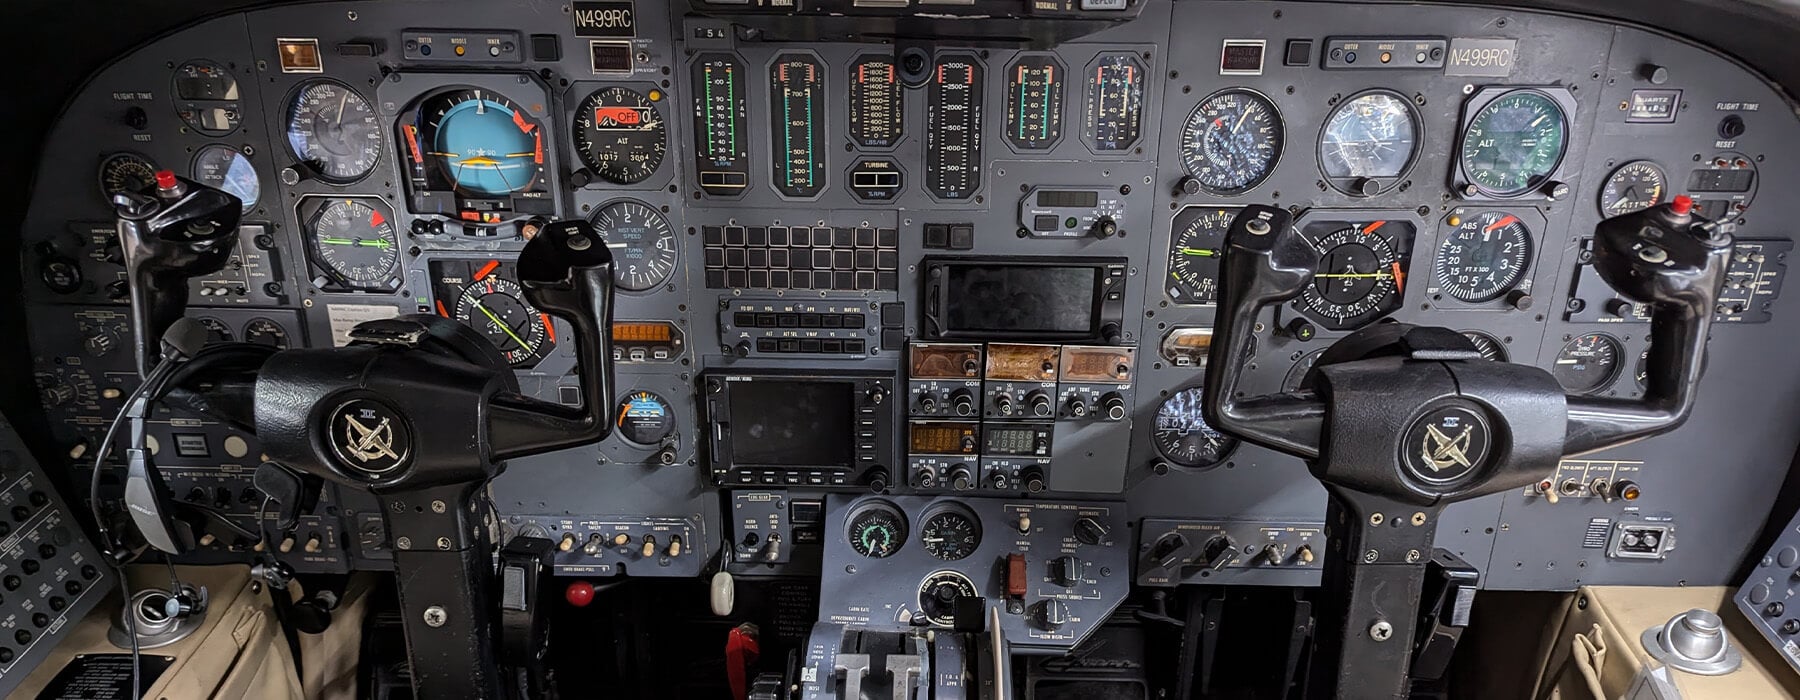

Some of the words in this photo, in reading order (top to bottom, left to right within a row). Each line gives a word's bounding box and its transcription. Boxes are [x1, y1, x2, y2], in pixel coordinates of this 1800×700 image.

[1035, 2, 1058, 10] NORMAL
[575, 9, 632, 28] N499RC
[1450, 48, 1509, 66] N499RC
[113, 92, 135, 100] FLIGHT
[137, 92, 152, 100] TIME
[616, 94, 622, 103] 0
[597, 98, 603, 107] 9
[1716, 103, 1740, 111] FLIGHT
[1742, 103, 1760, 111] TIME
[584, 119, 591, 128] 8
[586, 141, 593, 150] 7
[617, 137, 629, 145] ALT
[1478, 139, 1495, 148] ALT
[1715, 141, 1736, 149] RESET
[654, 143, 660, 152] 3
[602, 161, 609, 169] 6
[641, 161, 647, 170] 4
[622, 167, 629, 176] 5
[624, 213, 632, 223] 2
[644, 219, 651, 229] 4
[1461, 222, 1477, 230] ABS
[1458, 232, 1475, 240] ALT
[1497, 229, 1502, 240] 1
[1336, 235, 1347, 245] 12
[1355, 235, 1366, 244] 15
[656, 240, 663, 249] 6
[1503, 242, 1512, 253] 2
[1450, 245, 1462, 254] 25
[648, 259, 655, 269] 4
[1448, 256, 1460, 265] 20
[1500, 259, 1508, 270] 3
[629, 264, 637, 275] 2
[1450, 267, 1460, 275] 15
[441, 276, 463, 284] COURSE
[1458, 275, 1469, 283] 10
[1486, 271, 1495, 281] 4
[1470, 276, 1479, 287] 5
[479, 287, 487, 295] 12
[497, 285, 505, 293] 15
[1329, 304, 1342, 313] 33
[1347, 302, 1361, 312] 30
